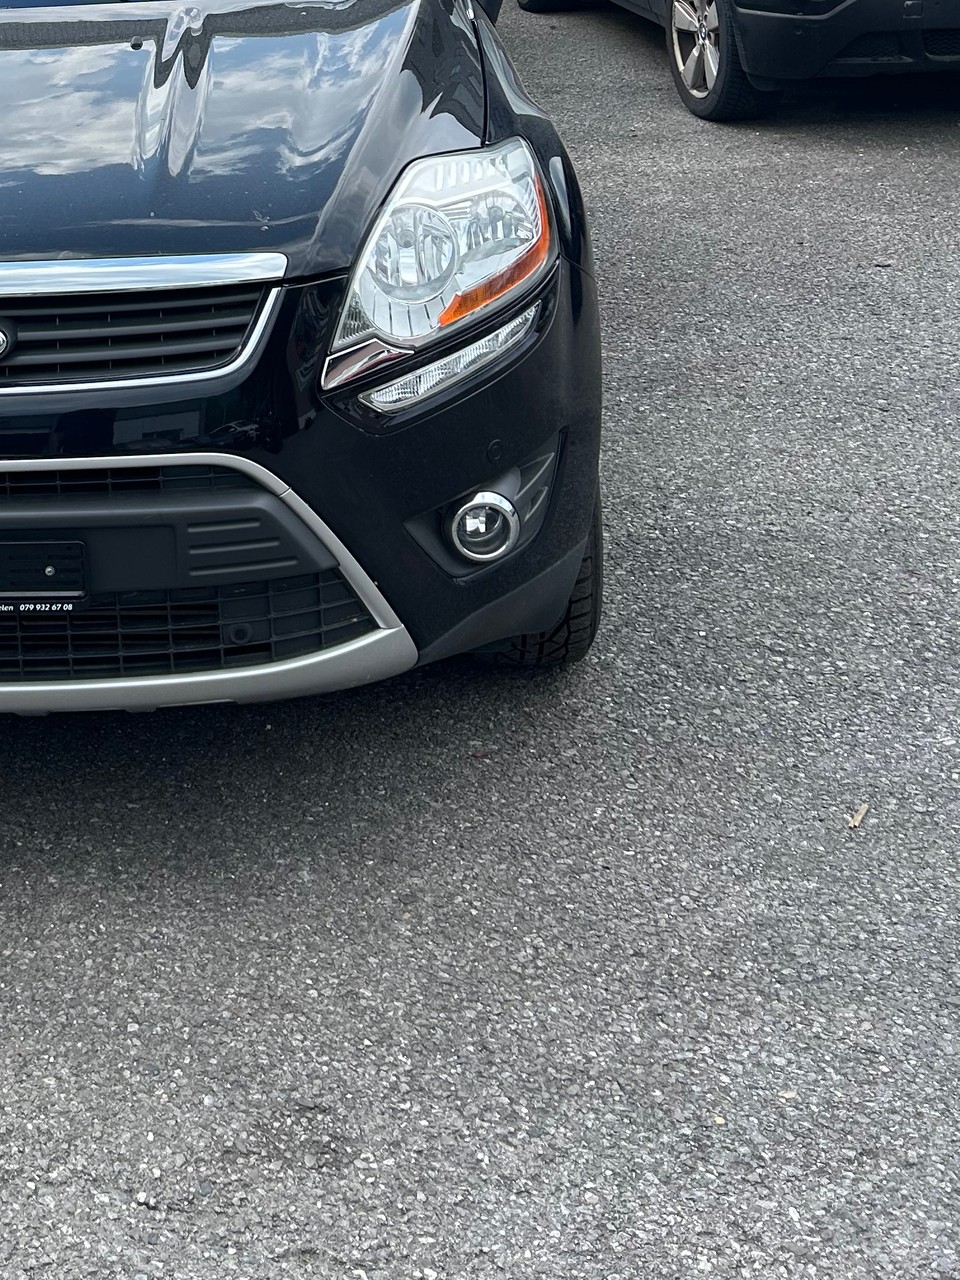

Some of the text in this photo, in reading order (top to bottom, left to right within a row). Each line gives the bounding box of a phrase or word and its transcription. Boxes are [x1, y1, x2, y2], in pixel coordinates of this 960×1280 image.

[19, 603, 35, 611] 079
[35, 603, 50, 611] 932
[51, 603, 62, 611] 67
[62, 603, 73, 611] 08
